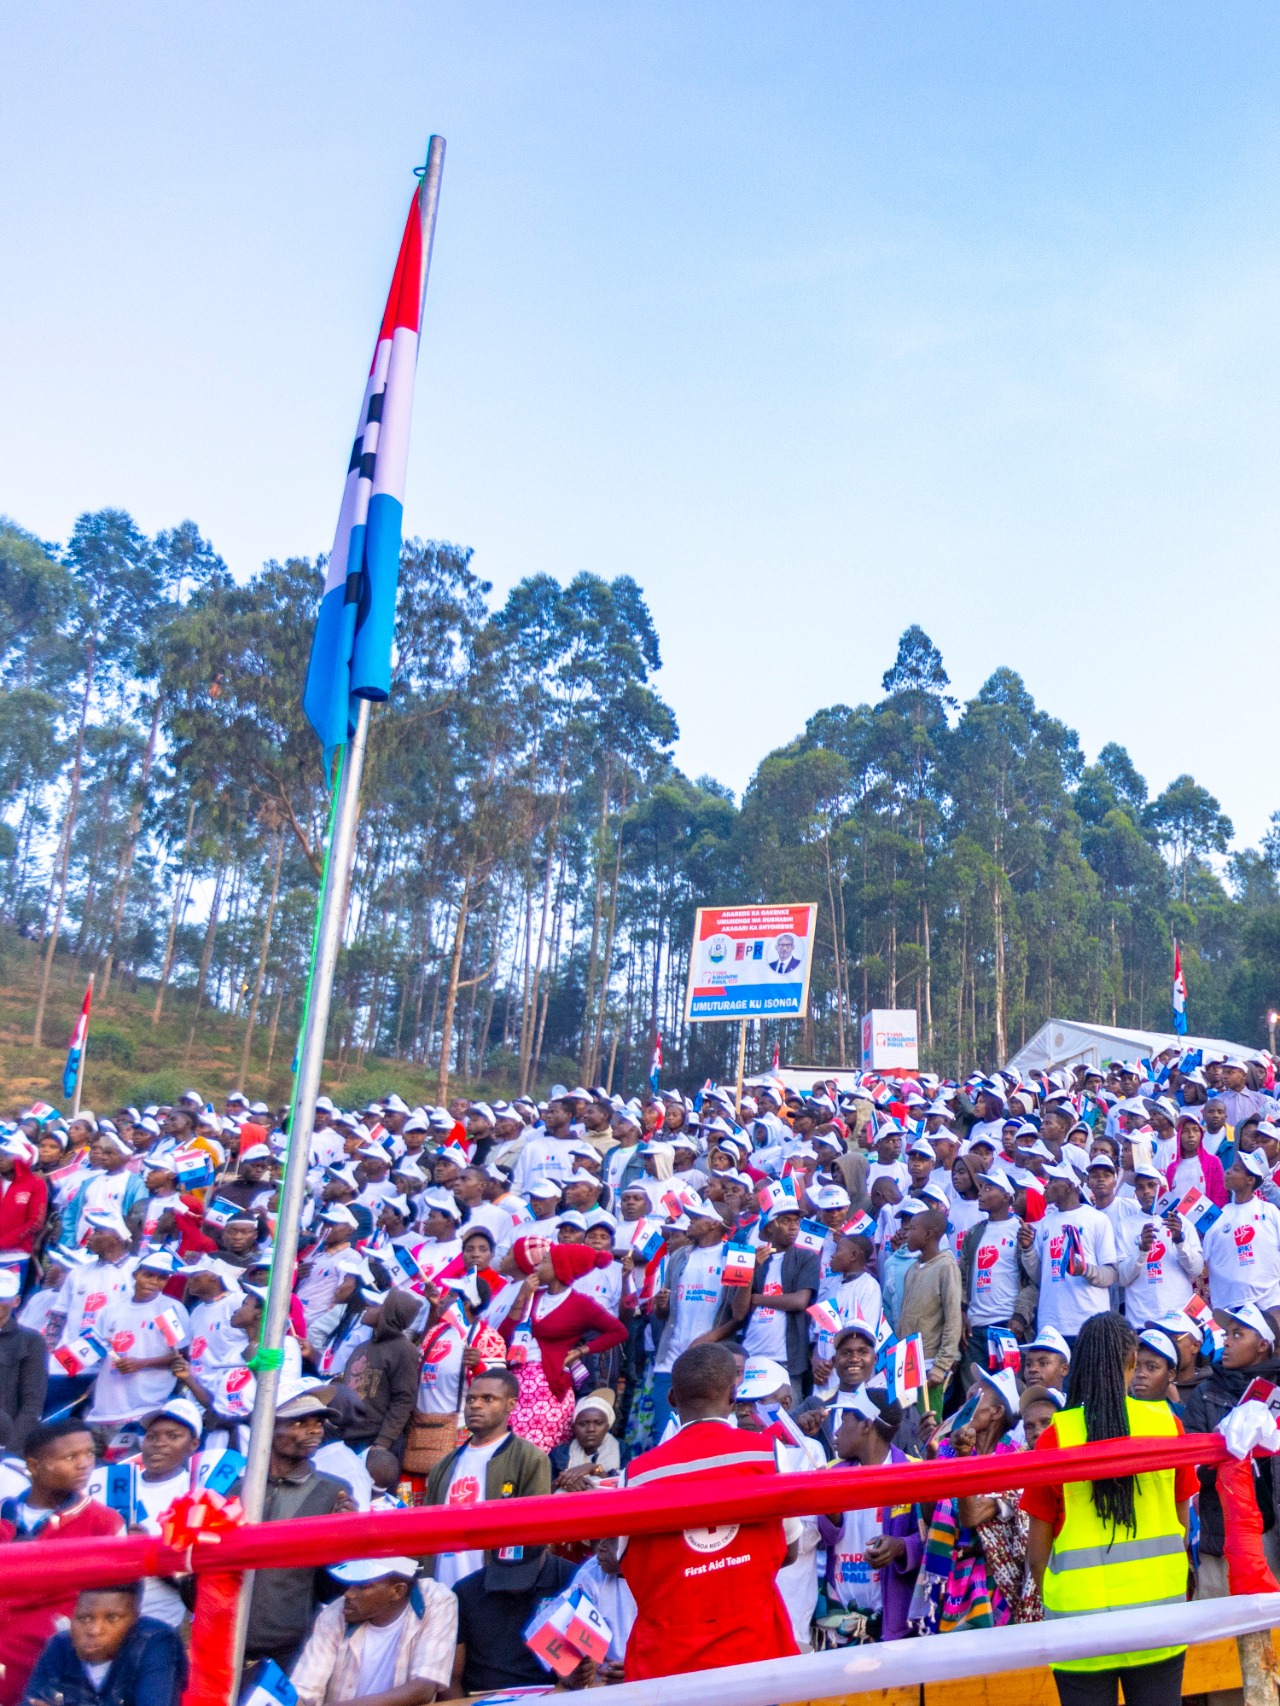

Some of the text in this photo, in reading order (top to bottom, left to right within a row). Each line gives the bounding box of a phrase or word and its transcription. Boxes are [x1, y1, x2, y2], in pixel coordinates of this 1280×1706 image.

[737, 944, 763, 957] FPR
[693, 997, 799, 1011] UMUTURAGE KU ISONGA
[761, 1184, 793, 1204] FPR
[1184, 1195, 1215, 1224] FPR
[391, 1257, 415, 1277] PR
[200, 1463, 236, 1481] PR
[89, 1477, 128, 1495] PR
[687, 1525, 737, 1549] RWANDA RED CROSS
[685, 1554, 751, 1577] First Aid Team
[579, 1609, 602, 1649] FP
